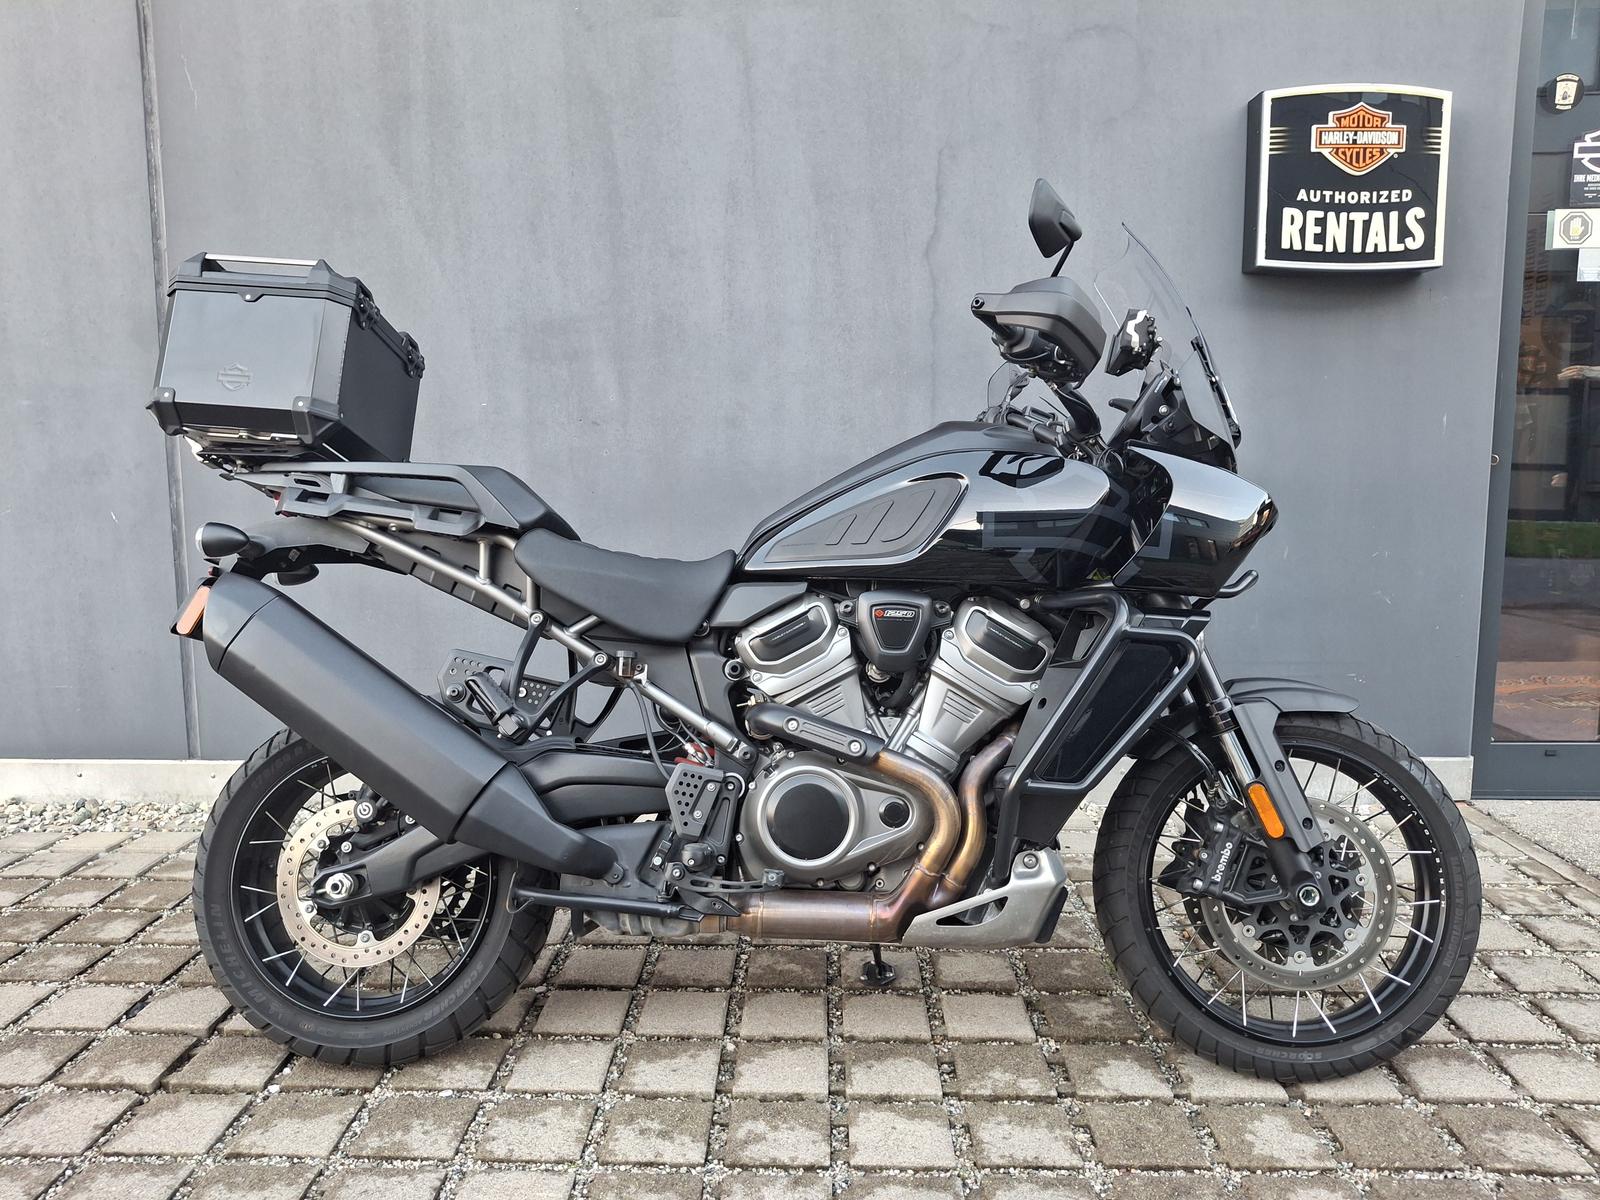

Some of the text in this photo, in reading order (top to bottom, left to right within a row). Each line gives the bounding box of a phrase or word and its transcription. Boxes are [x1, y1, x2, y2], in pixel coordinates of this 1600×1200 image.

[1340, 111, 1382, 127] MOTOR
[1321, 131, 1399, 144] HARLEY-DAVIDSON
[1338, 148, 1381, 167] CYCLES
[1296, 188, 1413, 204] AUTHORIZED
[1281, 206, 1426, 254] RENTALS
[1211, 842, 1233, 882] brembo
[210, 904, 266, 1003] MICHELIN
